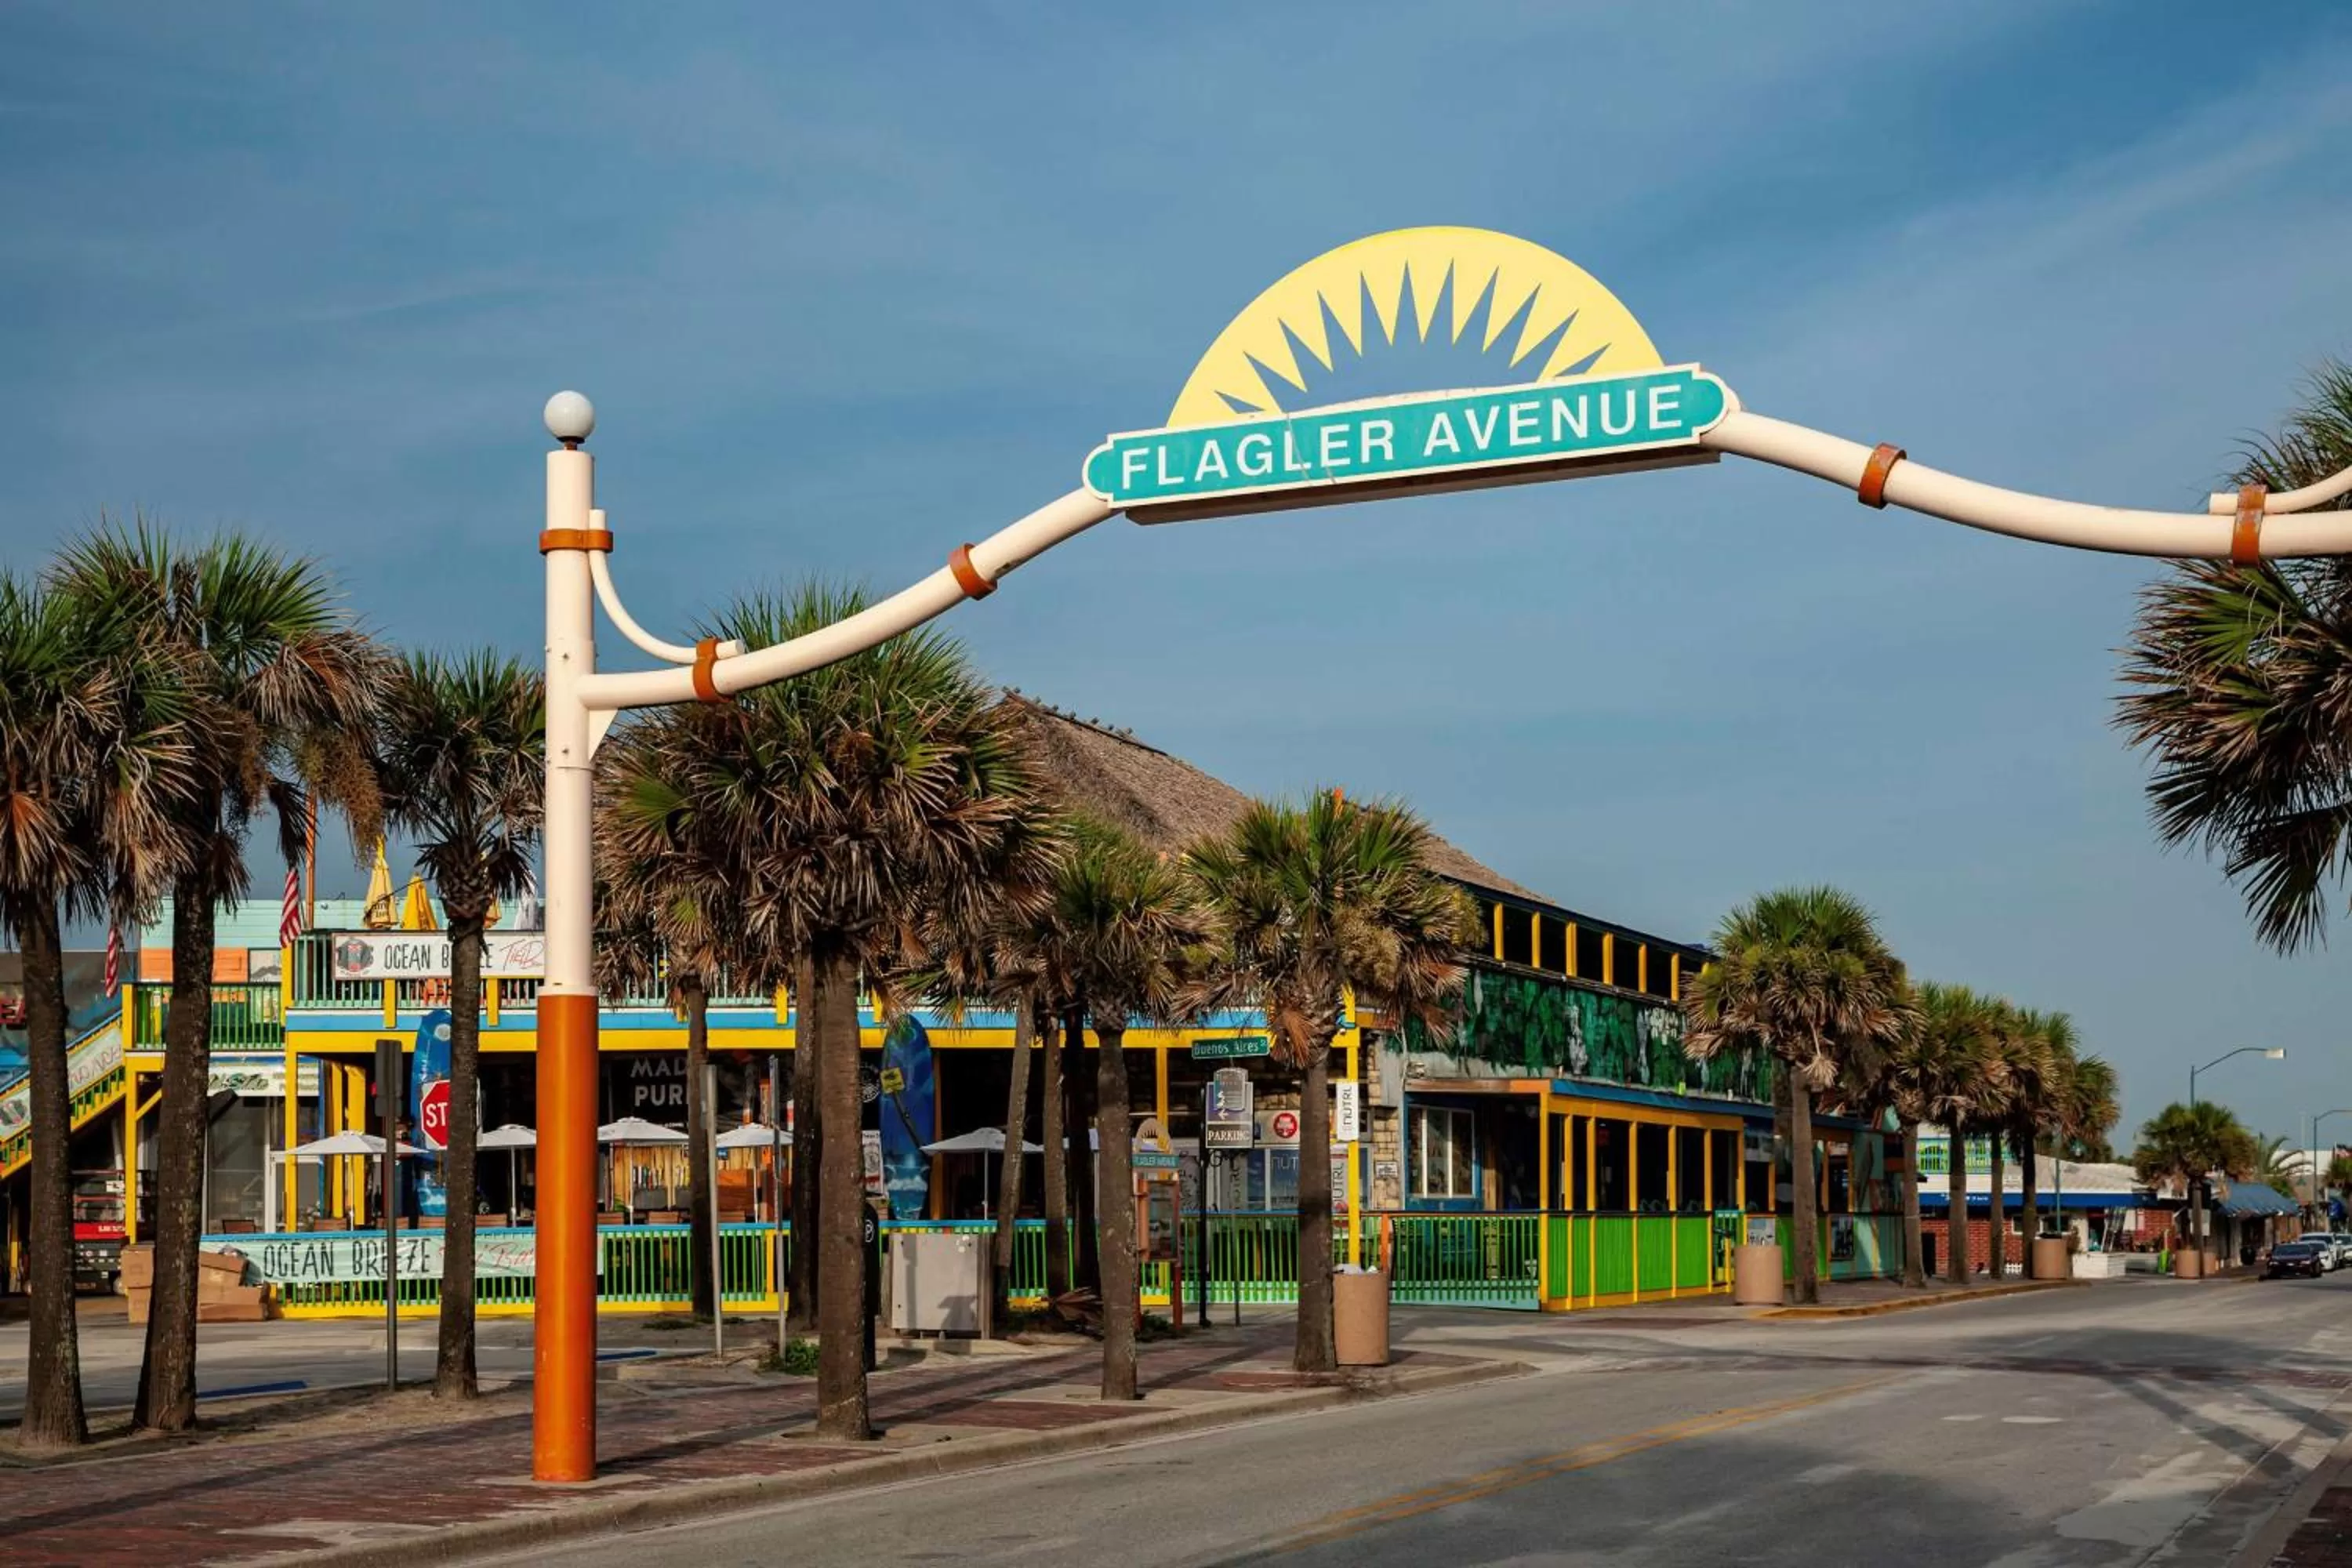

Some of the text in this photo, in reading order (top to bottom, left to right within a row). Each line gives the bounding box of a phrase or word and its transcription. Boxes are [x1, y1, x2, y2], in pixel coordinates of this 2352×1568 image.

[1122, 384, 1682, 490] FLAGLER AVENUE
[384, 943, 431, 971] OCEAN
[1194, 1042, 1229, 1055] Buenos
[1233, 1040, 1259, 1052] Aires
[630, 1057, 688, 1078] MAD
[634, 1083, 688, 1107] PUR
[426, 1102, 448, 1128] ST
[1208, 1129, 1250, 1142] PARKING
[263, 1240, 335, 1279] OCEAN
